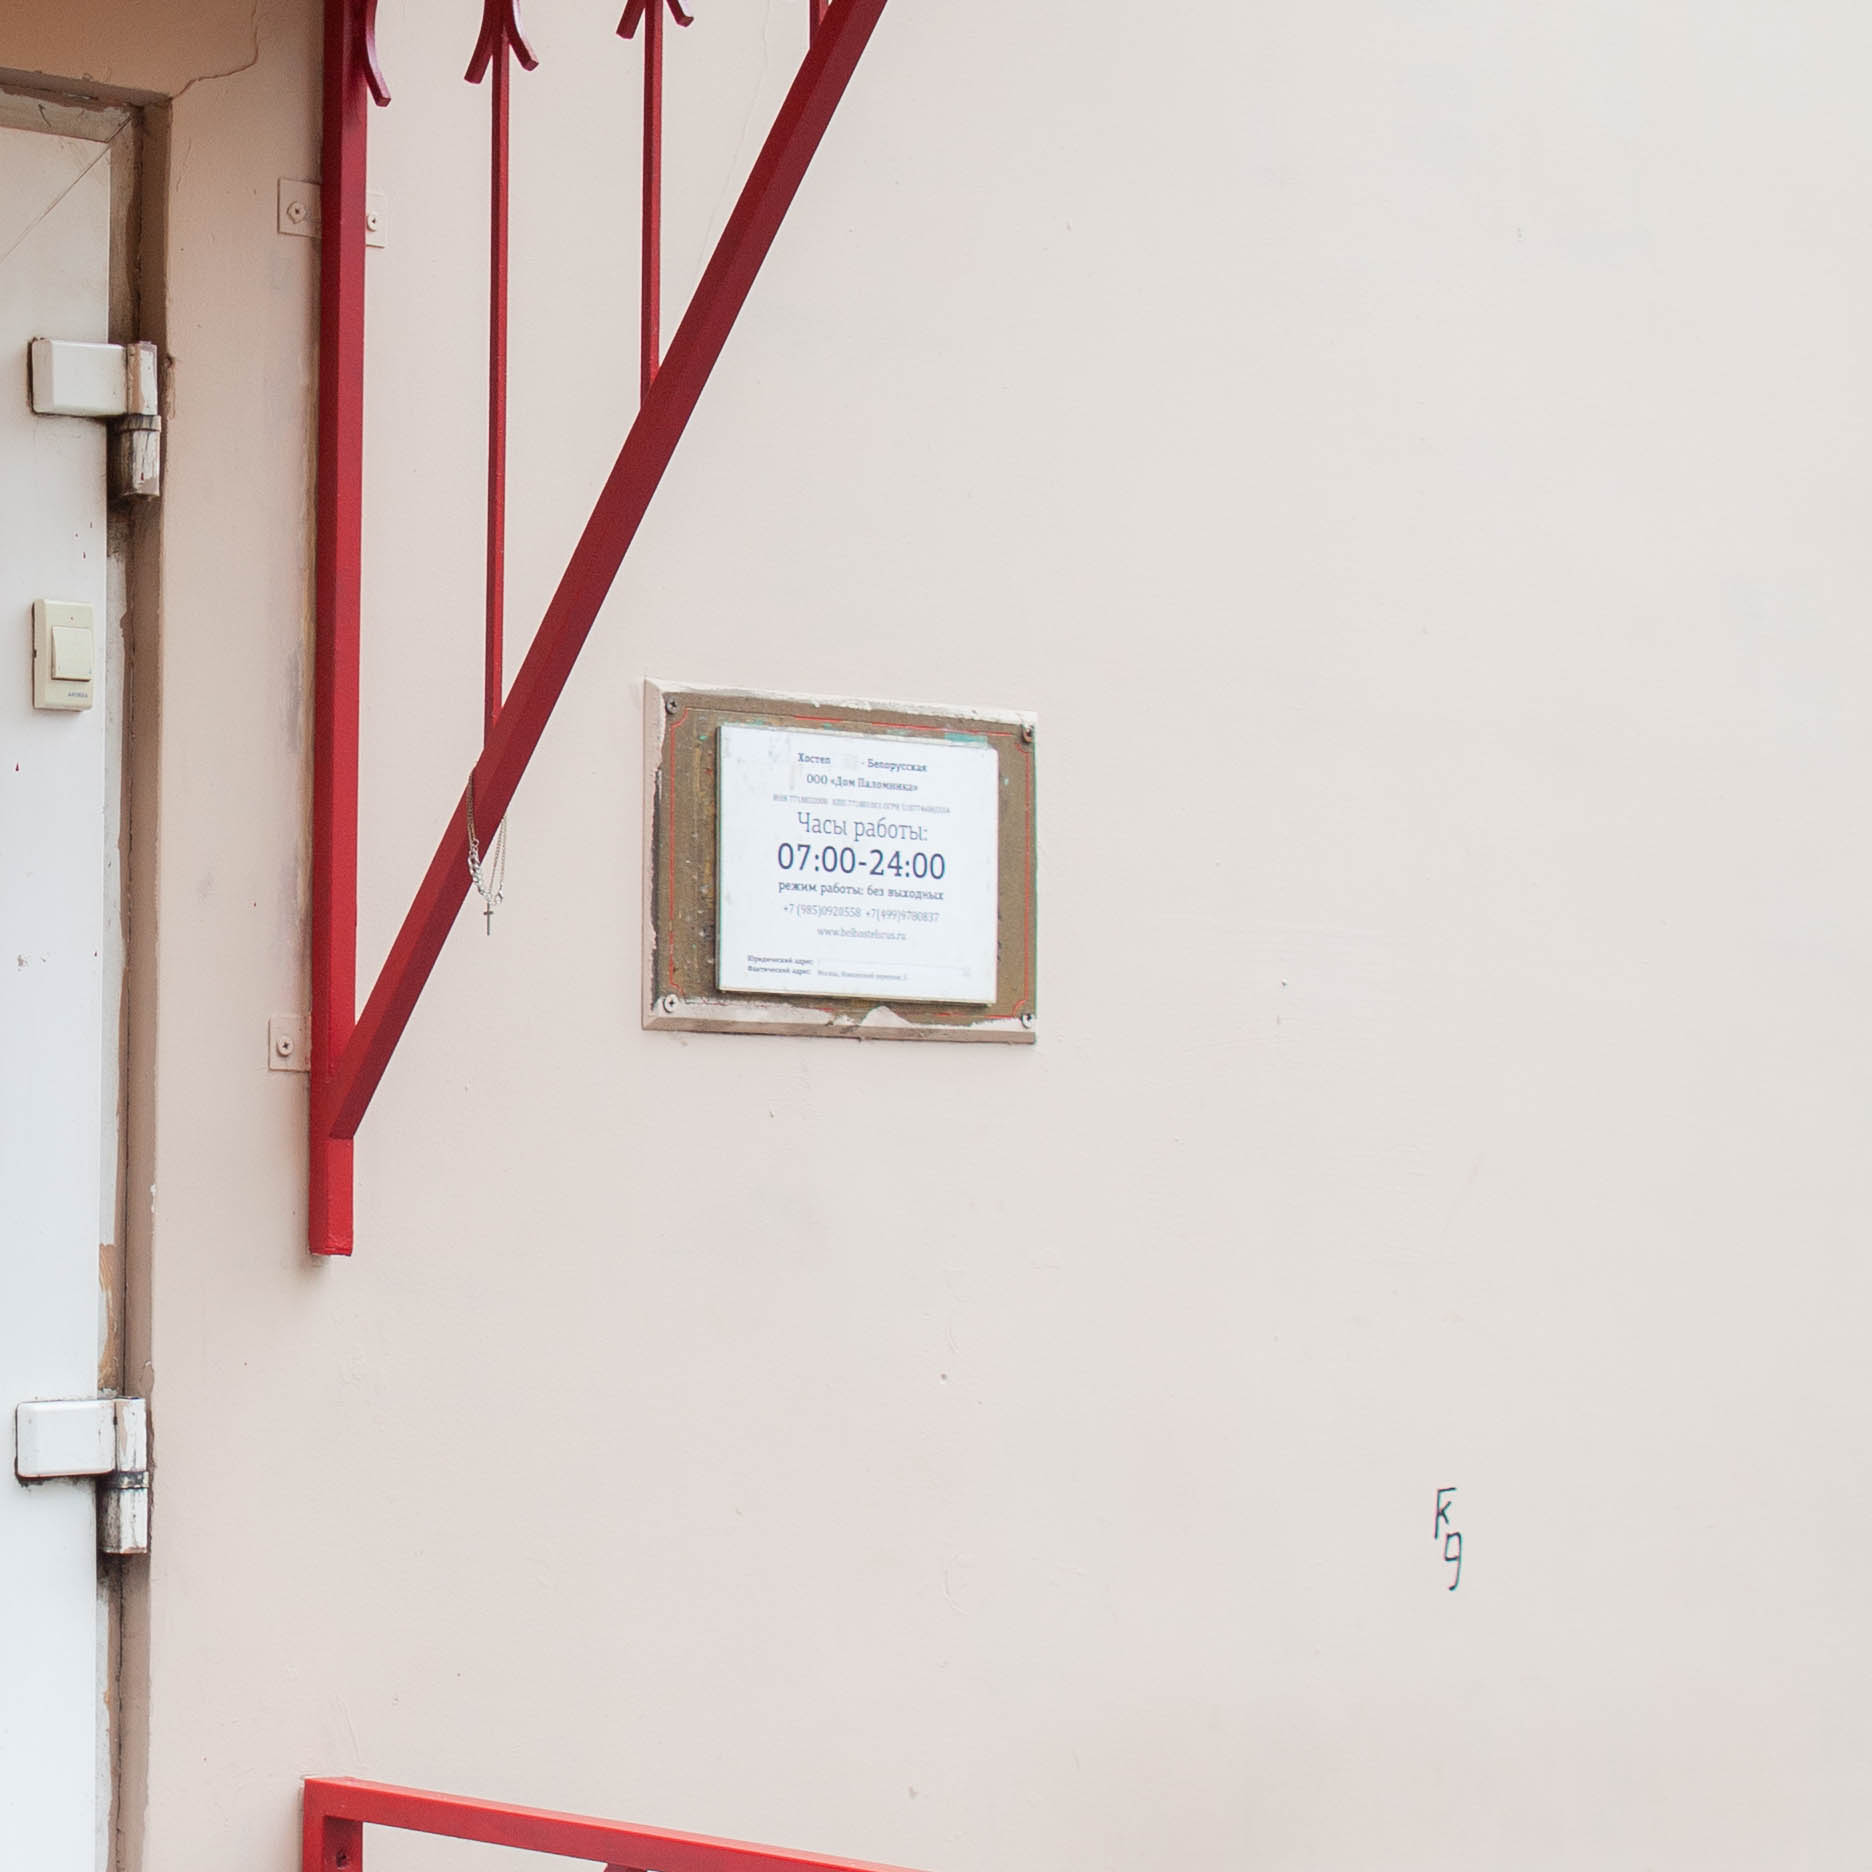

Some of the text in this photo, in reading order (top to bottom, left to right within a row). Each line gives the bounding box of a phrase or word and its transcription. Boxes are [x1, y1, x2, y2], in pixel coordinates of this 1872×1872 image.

[867, 759, 927, 773] Белорусская
[807, 773, 827, 785] ООО
[831, 776, 855, 788] «Дом
[798, 811, 928, 842] Часы работы:
[778, 842, 946, 879] 07:00-24:00
[778, 881, 944, 901] режим работы: без выходных
